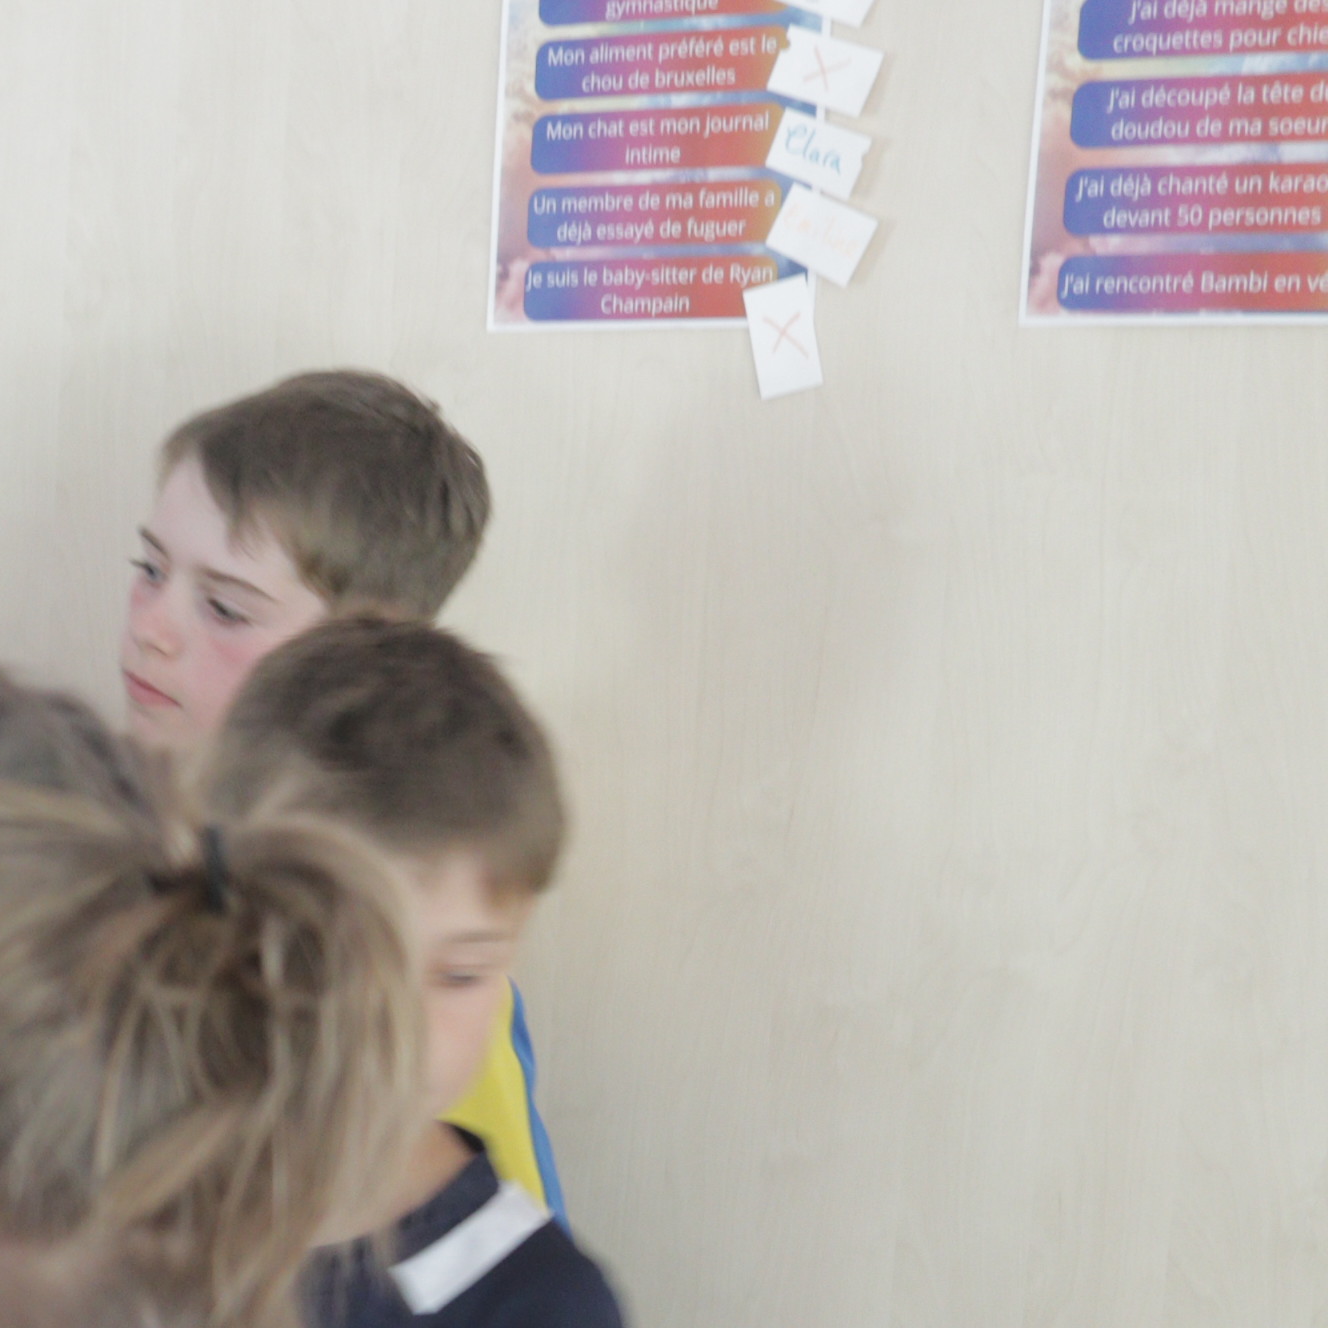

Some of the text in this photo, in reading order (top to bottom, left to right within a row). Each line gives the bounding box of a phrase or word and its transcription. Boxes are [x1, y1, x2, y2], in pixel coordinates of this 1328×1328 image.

[547, 33, 779, 66] Mon aliment préféré est le
[1112, 23, 1328, 55] croquettes pour chie
[581, 65, 736, 93] chou de bruxelles
[1106, 86, 1136, 114] J'ai
[1141, 82, 1231, 110] découpé
[1237, 82, 1256, 104] la
[1261, 80, 1305, 103] tête
[546, 111, 770, 142] Mon chat est mon journal
[1111, 116, 1190, 141] doudou
[1196, 116, 1222, 139] de
[1229, 119, 1263, 137] ma
[625, 144, 682, 165] intime
[786, 123, 842, 176] Clara
[533, 186, 776, 215] Un membre de ma famille a
[1075, 170, 1328, 202] J'ai déjà chanté un karao
[556, 215, 747, 246] déjà essayé de fuguer
[1102, 205, 1322, 231] devant 50 personnes
[525, 262, 774, 292] Je suis le baby-sitter de Ryan
[1061, 273, 1090, 299] J'ai
[1095, 270, 1194, 294] rencontré
[1200, 269, 1268, 293] Bambi
[1274, 274, 1301, 293] en
[600, 292, 691, 317] Champain
